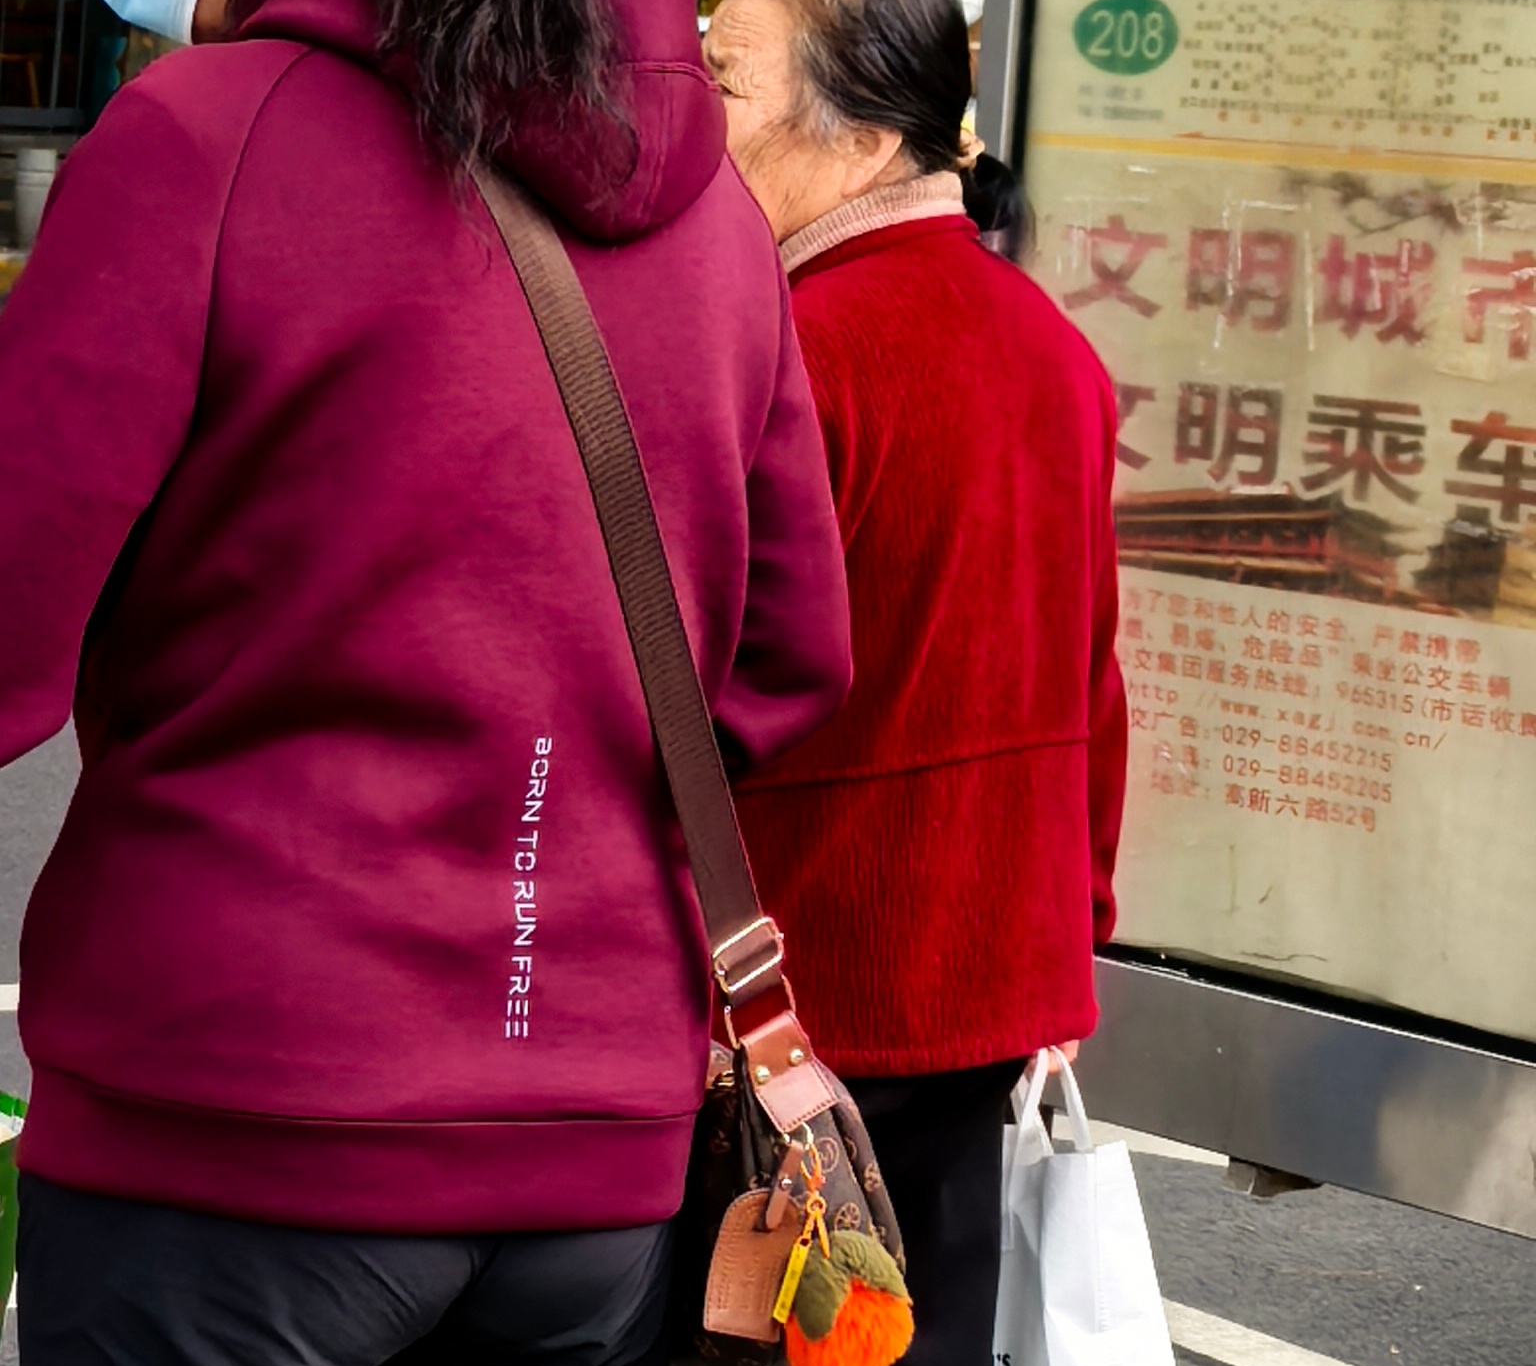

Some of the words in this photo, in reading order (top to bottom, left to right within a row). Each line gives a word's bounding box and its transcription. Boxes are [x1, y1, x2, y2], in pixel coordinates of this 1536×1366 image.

[1087, 10, 1164, 60] 208
[1065, 213, 1536, 360] 文明城市
[520, 737, 552, 823] BORN
[514, 830, 539, 872] TO
[513, 881, 537, 947] RUN
[505, 955, 533, 1038] FREE
